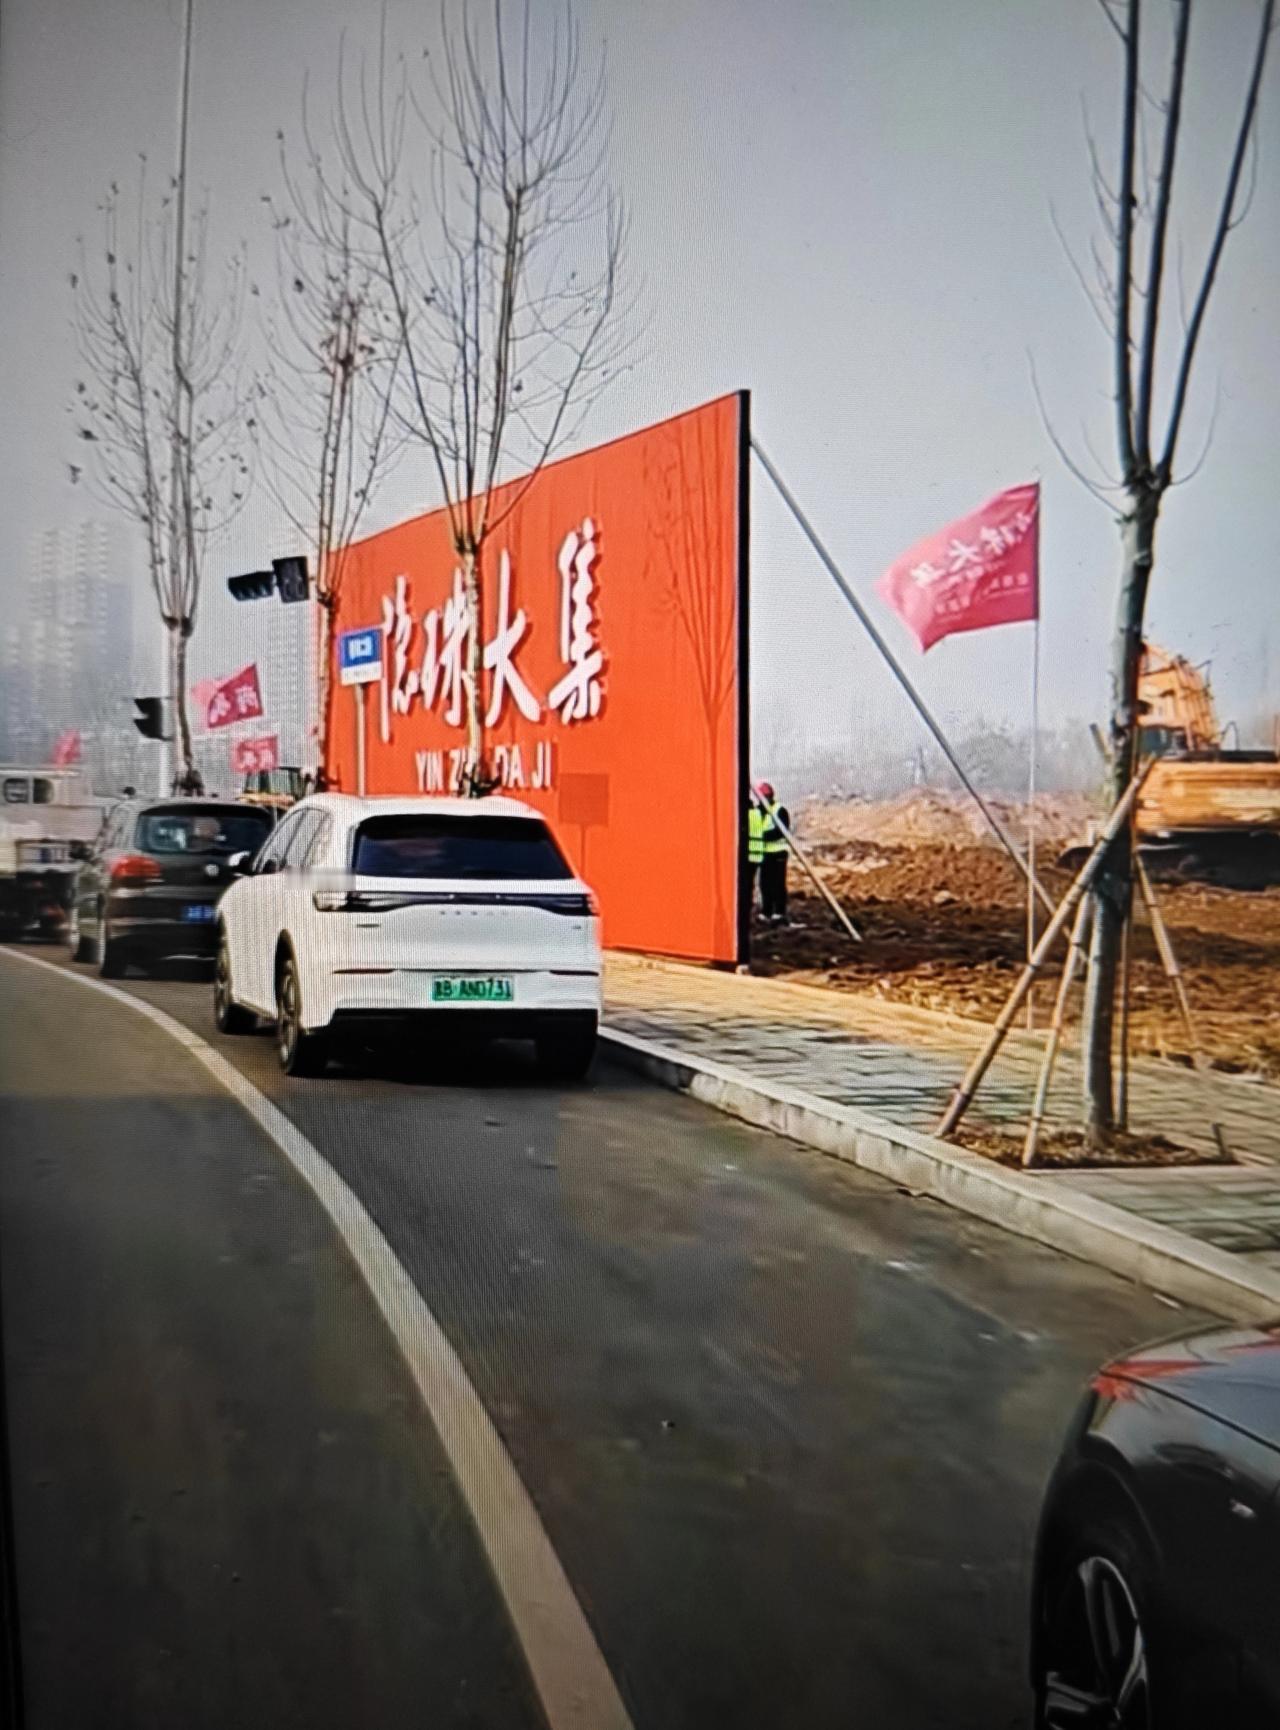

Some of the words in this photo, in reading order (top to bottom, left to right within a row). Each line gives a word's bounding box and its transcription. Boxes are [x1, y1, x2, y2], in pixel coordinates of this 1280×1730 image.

[415, 750, 443, 793] YIN
[491, 744, 524, 789] DA
[531, 741, 551, 790] JI
